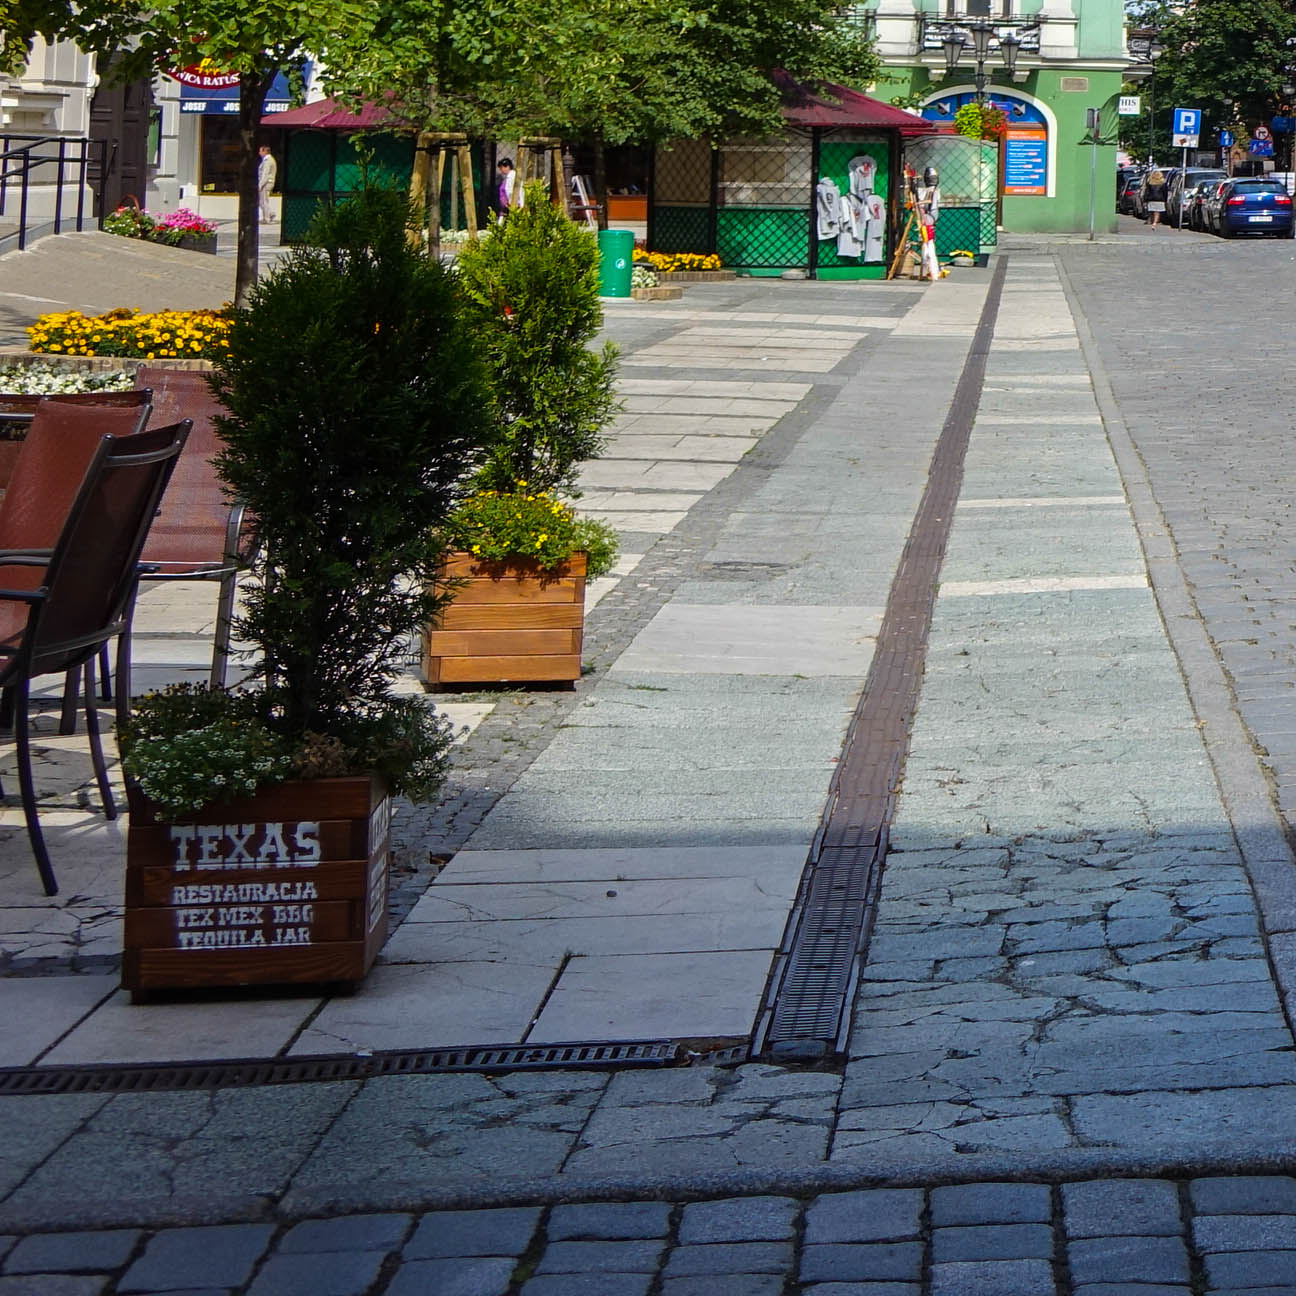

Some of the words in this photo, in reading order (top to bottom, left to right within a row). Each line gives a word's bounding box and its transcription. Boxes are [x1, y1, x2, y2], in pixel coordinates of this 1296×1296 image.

[203, 71, 240, 86] RATUS
[223, 102, 241, 112] JOS
[1179, 111, 1196, 132] P
[171, 822, 321, 871] TEXAS
[173, 882, 318, 904] RESTAURACJA
[176, 909, 214, 927] TEX
[218, 907, 264, 926] MEX
[179, 929, 266, 948] TEQUILA
